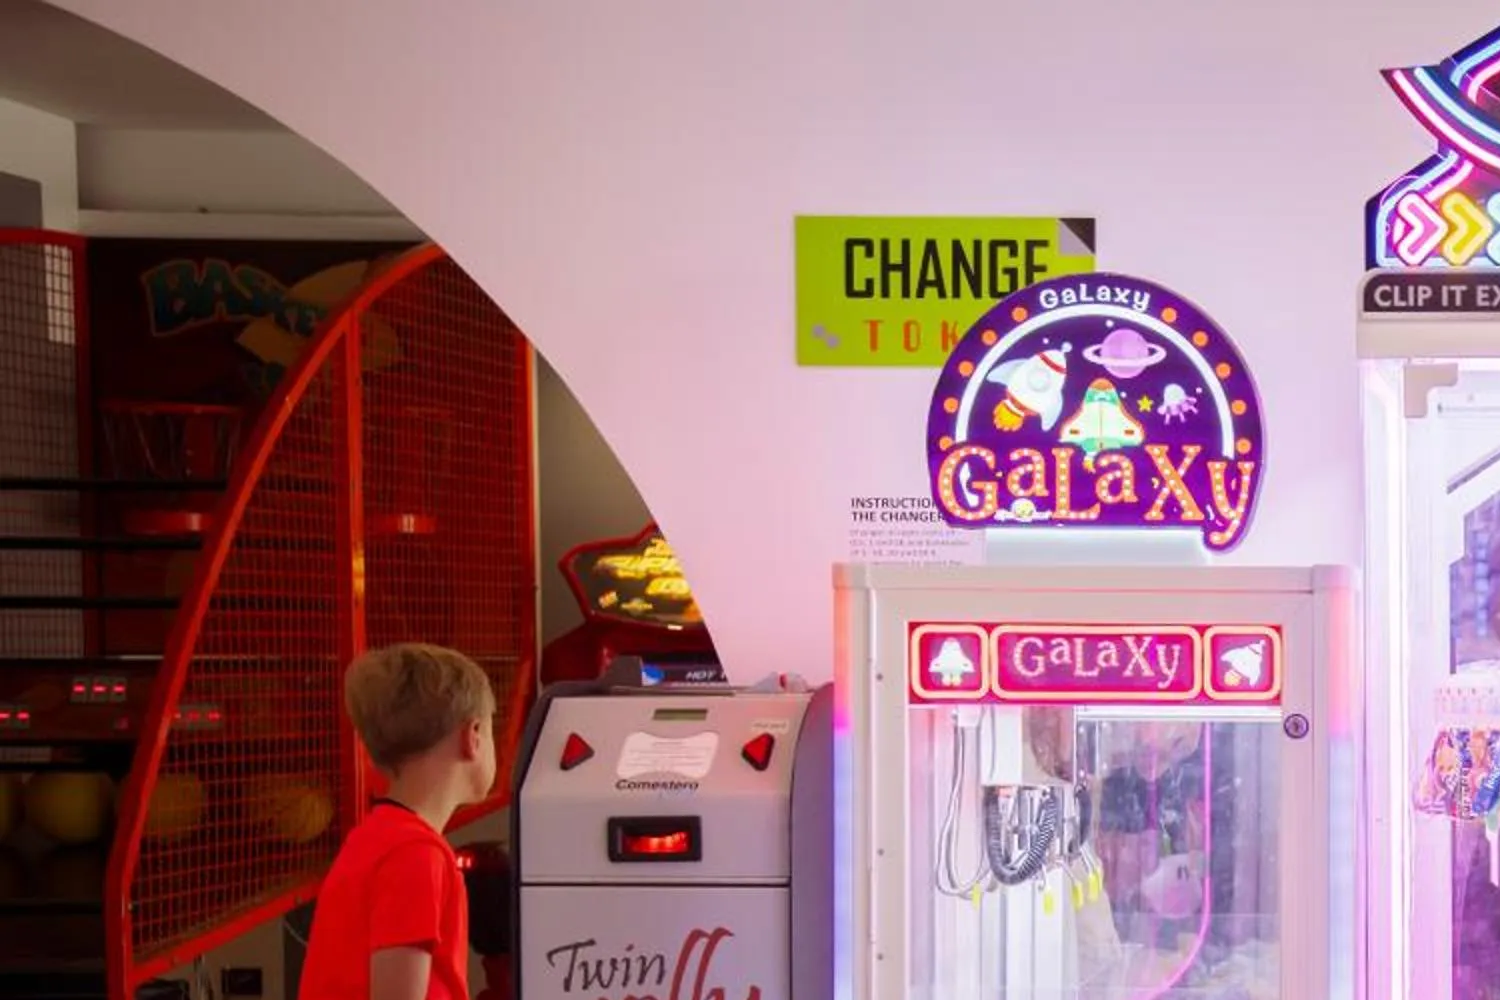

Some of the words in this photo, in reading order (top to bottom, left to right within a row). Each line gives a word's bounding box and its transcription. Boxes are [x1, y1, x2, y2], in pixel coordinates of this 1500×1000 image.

[844, 238, 1051, 300] CHANGE
[1373, 284, 1433, 307] CLIP
[1441, 284, 1468, 307] IT
[851, 511, 877, 523] THE
[614, 778, 700, 792] Comestero
[546, 938, 667, 993] Twin
